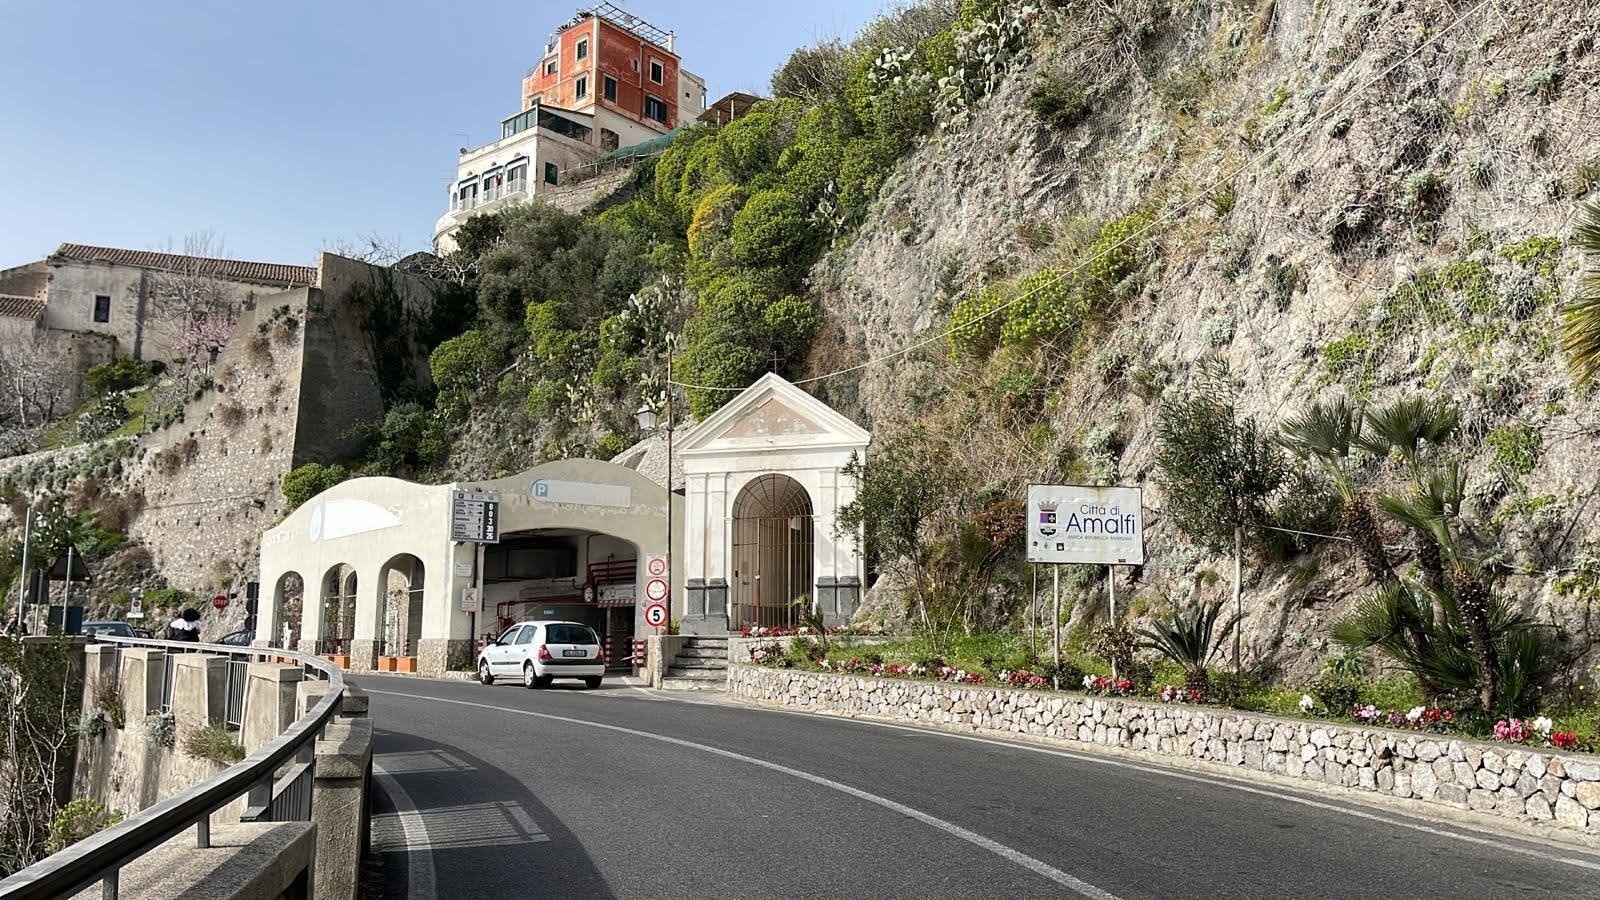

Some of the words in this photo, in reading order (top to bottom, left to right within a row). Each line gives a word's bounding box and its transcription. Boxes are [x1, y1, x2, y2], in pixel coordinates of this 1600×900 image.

[538, 484, 546, 496] P
[1080, 504, 1106, 515] Città
[1110, 505, 1120, 516] di
[1066, 512, 1135, 534] Amalfi
[653, 610, 660, 622] 5
